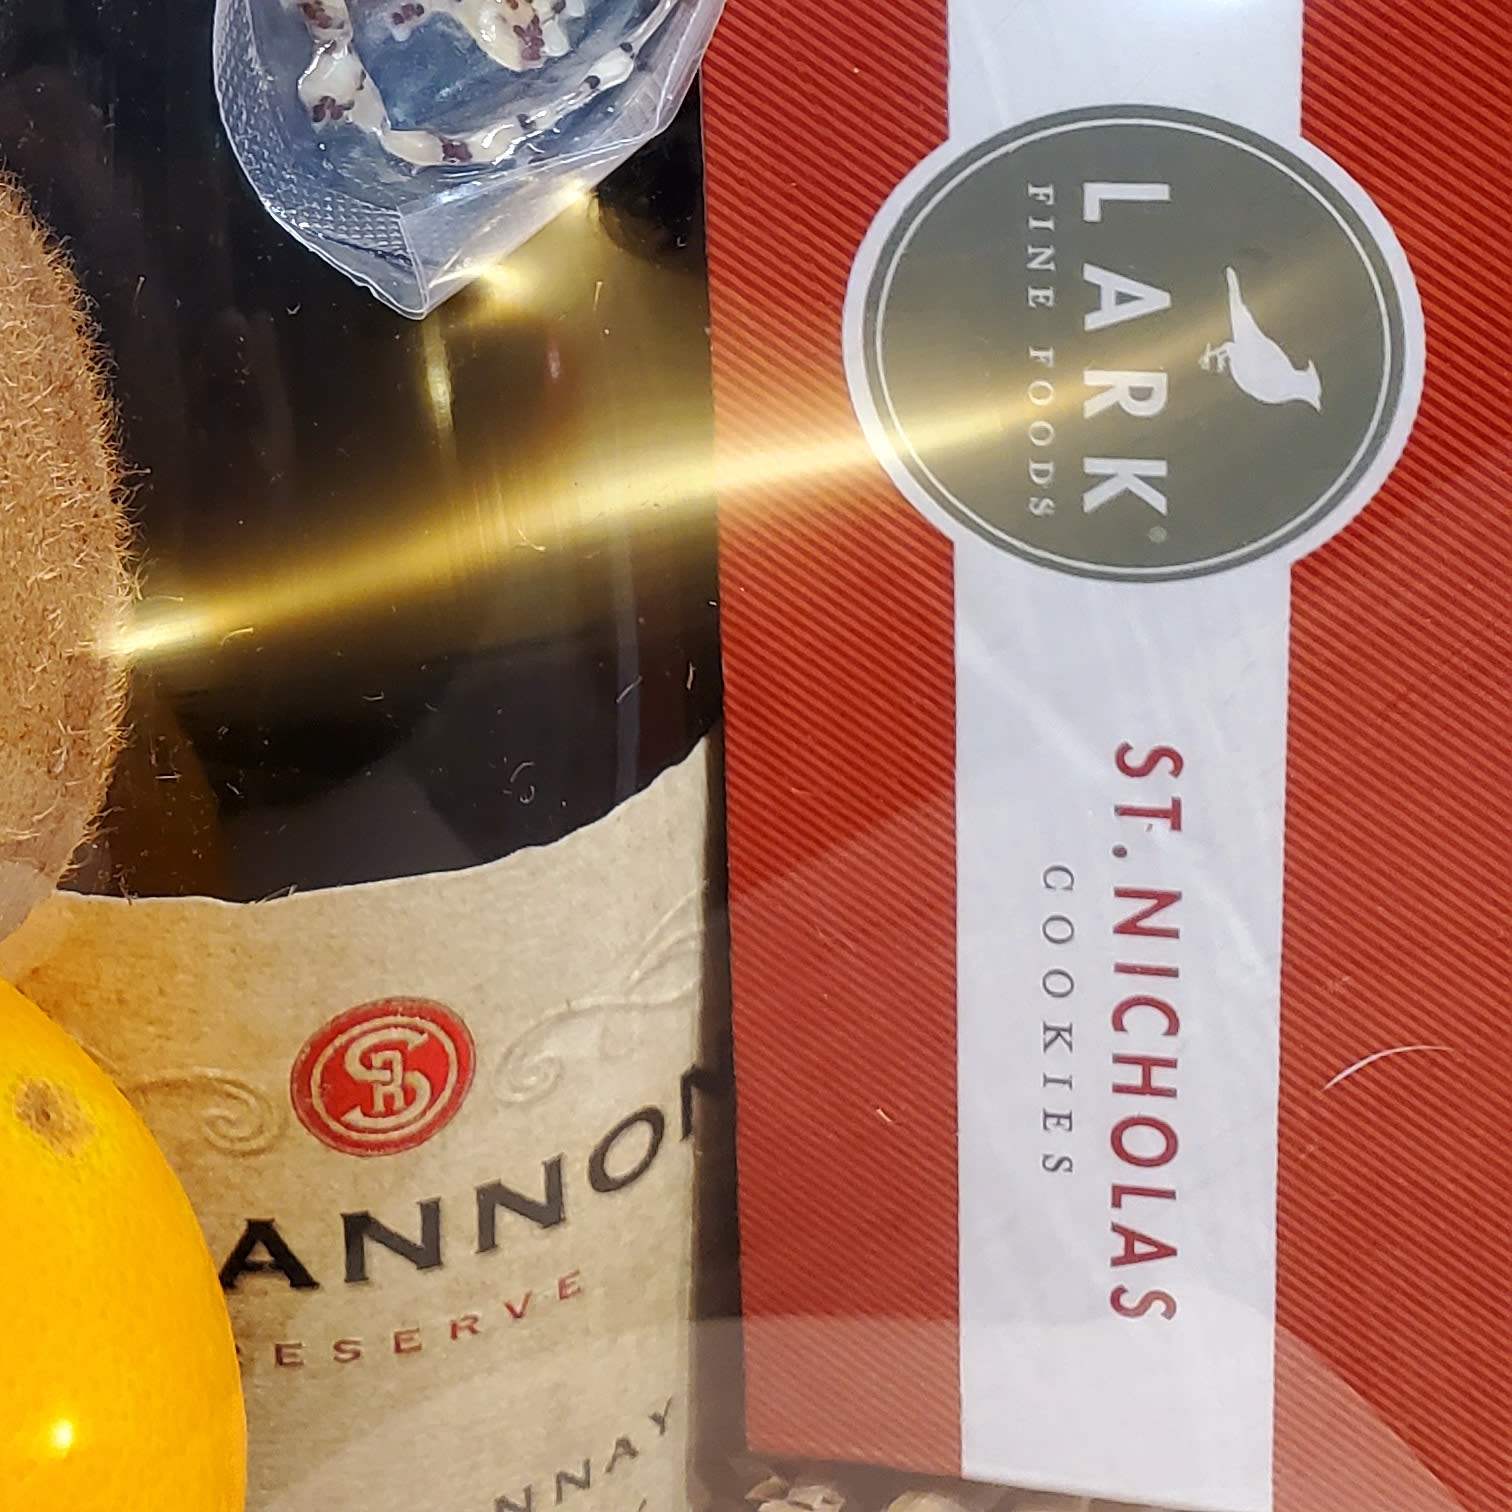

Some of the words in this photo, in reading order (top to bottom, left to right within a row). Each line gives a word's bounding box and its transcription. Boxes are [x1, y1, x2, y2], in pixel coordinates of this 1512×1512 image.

[1027, 183, 1055, 309] FINE
[1082, 182, 1172, 518] LARK
[1027, 345, 1055, 518] FOODS
[1041, 863, 1076, 1174] COOKIES
[1110, 885, 1183, 1322] NICHOLAS
[218, 1063, 713, 1290] ANNO
[235, 1270, 584, 1369] ESERVE
